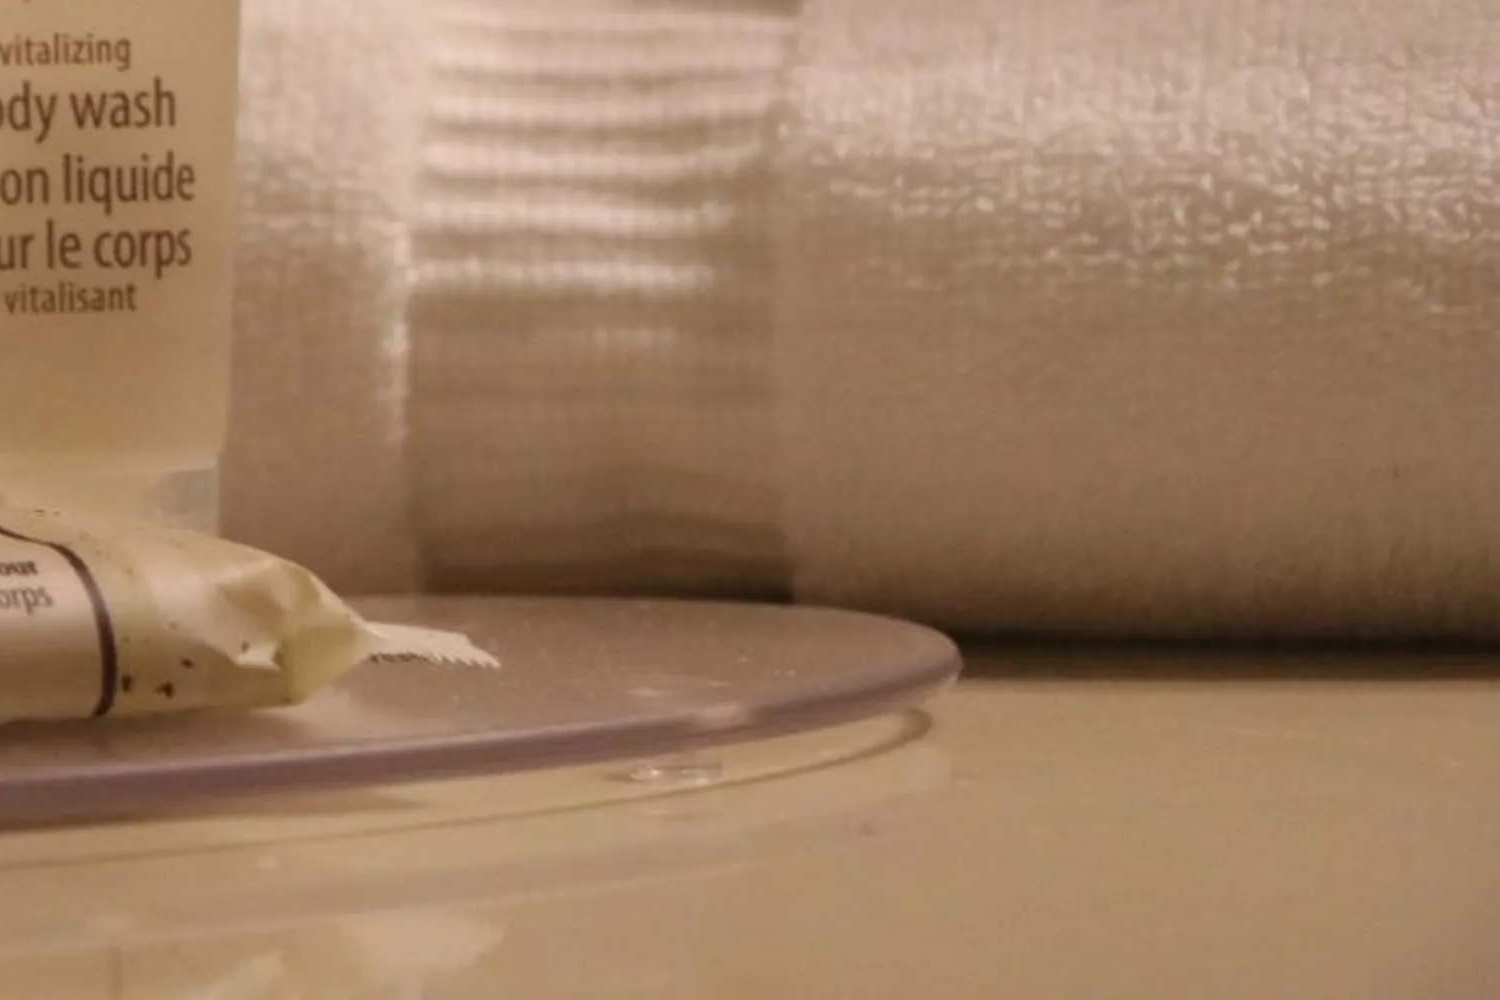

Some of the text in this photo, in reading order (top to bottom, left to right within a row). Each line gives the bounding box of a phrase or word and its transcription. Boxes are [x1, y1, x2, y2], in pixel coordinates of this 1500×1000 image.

[68, 75, 177, 130] wash
[62, 150, 196, 217] liquide
[46, 218, 83, 271] le
[92, 226, 193, 281] corps
[4, 280, 137, 316] vitalisant
